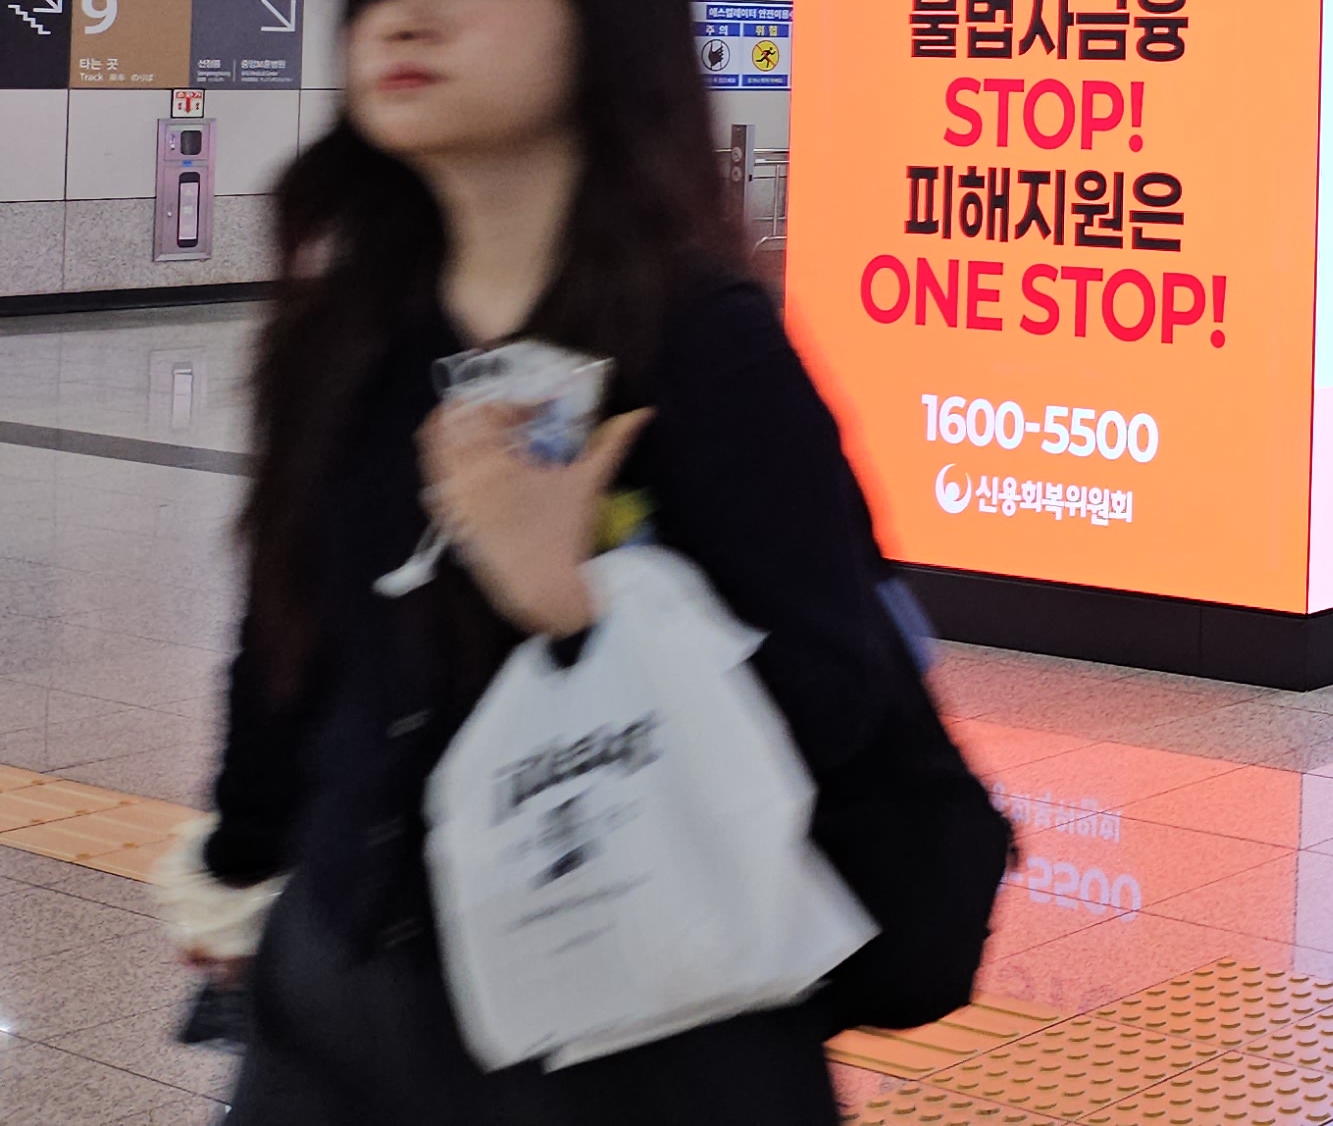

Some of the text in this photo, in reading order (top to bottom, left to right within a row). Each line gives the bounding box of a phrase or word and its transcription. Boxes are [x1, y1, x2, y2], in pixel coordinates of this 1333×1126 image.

[79, 58, 119, 71] 타는 곳
[80, 73, 103, 82] Track
[943, 77, 1145, 154] STOP!
[903, 165, 1185, 253] 피해지원은
[860, 254, 1228, 350] ONE STOP!
[921, 393, 1160, 463] 1600-5500
[975, 475, 1133, 526] 신용회복위원회
